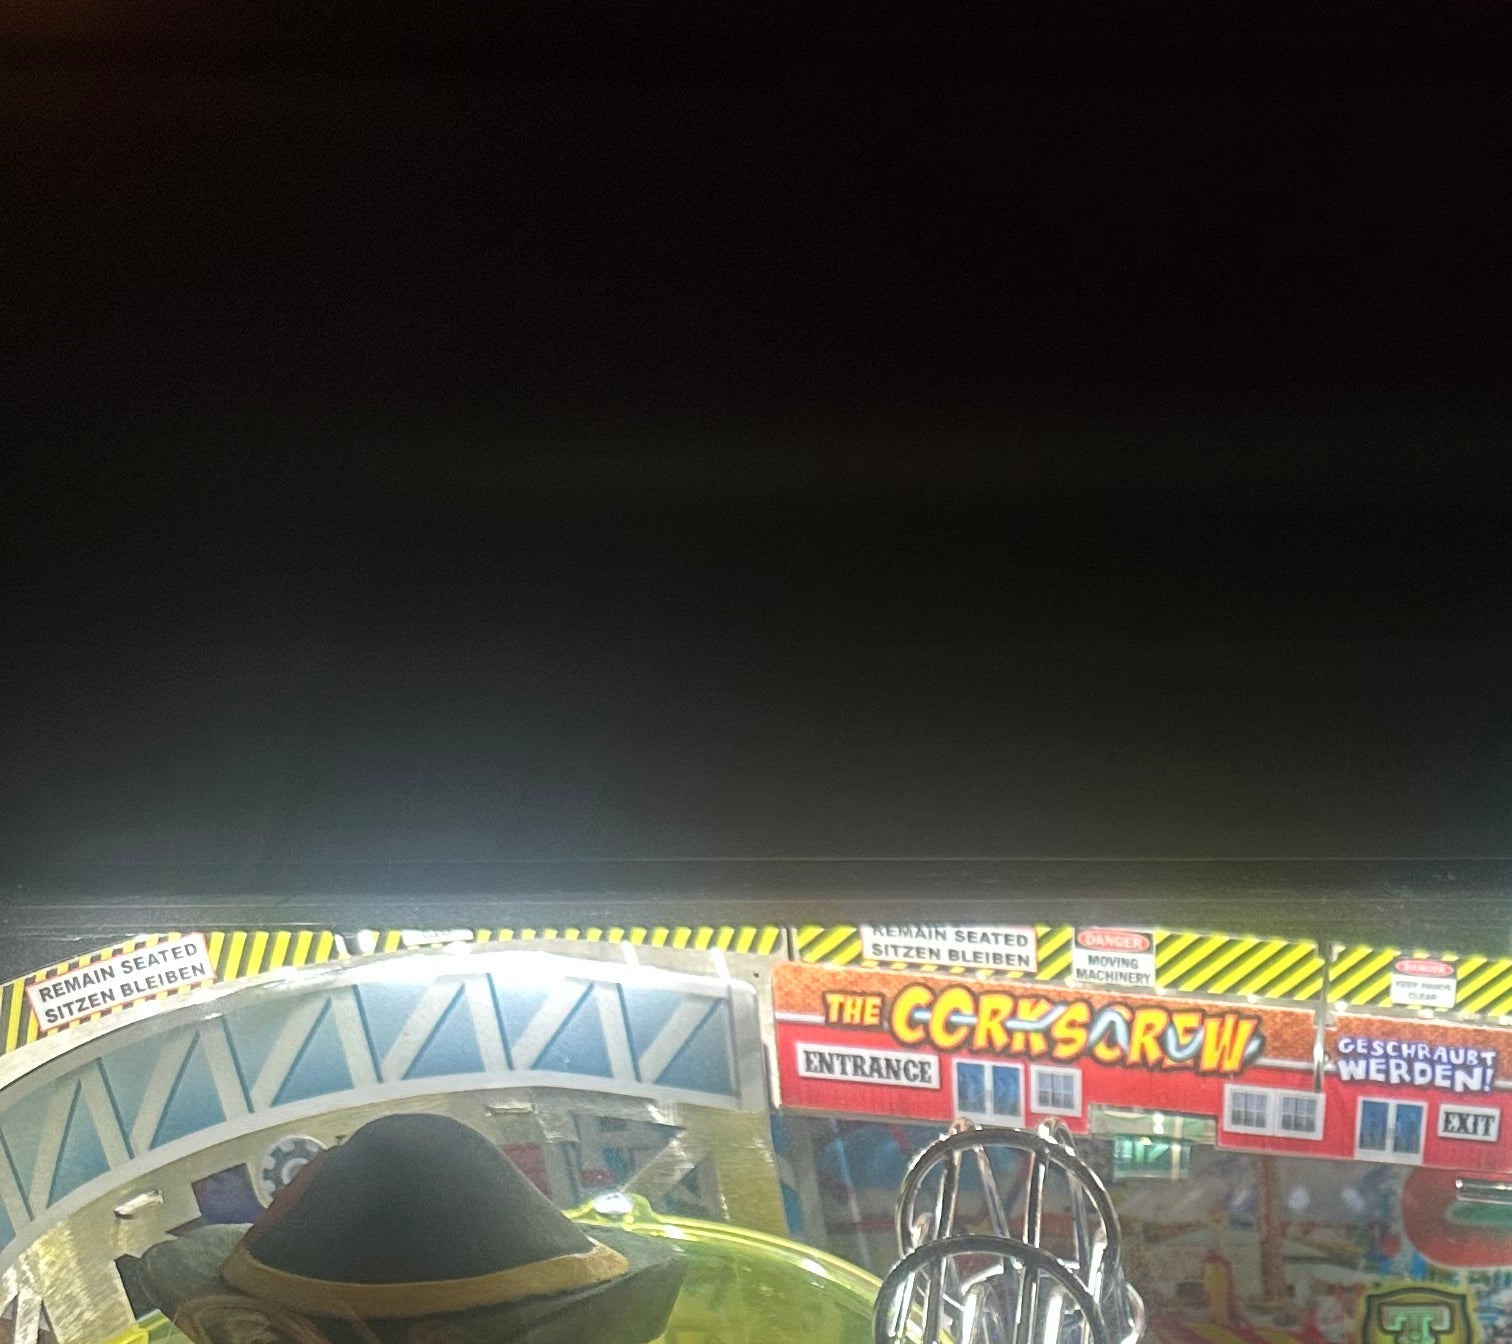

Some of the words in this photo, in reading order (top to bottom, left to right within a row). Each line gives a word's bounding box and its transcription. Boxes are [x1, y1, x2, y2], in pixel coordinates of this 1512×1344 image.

[955, 930, 1028, 948] SEATED
[1085, 931, 1143, 950] DANGER
[872, 943, 941, 961] SITZEN
[949, 949, 1030, 968] BLEIBEN
[1087, 954, 1139, 970] MOVING
[39, 965, 115, 1002] REMAIN
[120, 943, 197, 975] SEATED
[1076, 967, 1151, 985] MACHINERY
[45, 988, 115, 1024] SITZEN
[120, 962, 206, 998] BLEIBEN
[824, 992, 883, 1027] THE
[892, 982, 1264, 1076] CORKSCREW
[1337, 1037, 1496, 1067] GESCHRAUBT
[803, 1049, 934, 1084] ENTRANCE
[1337, 1057, 1495, 1093] WERDEN!
[1443, 1110, 1496, 1137] EXIT
